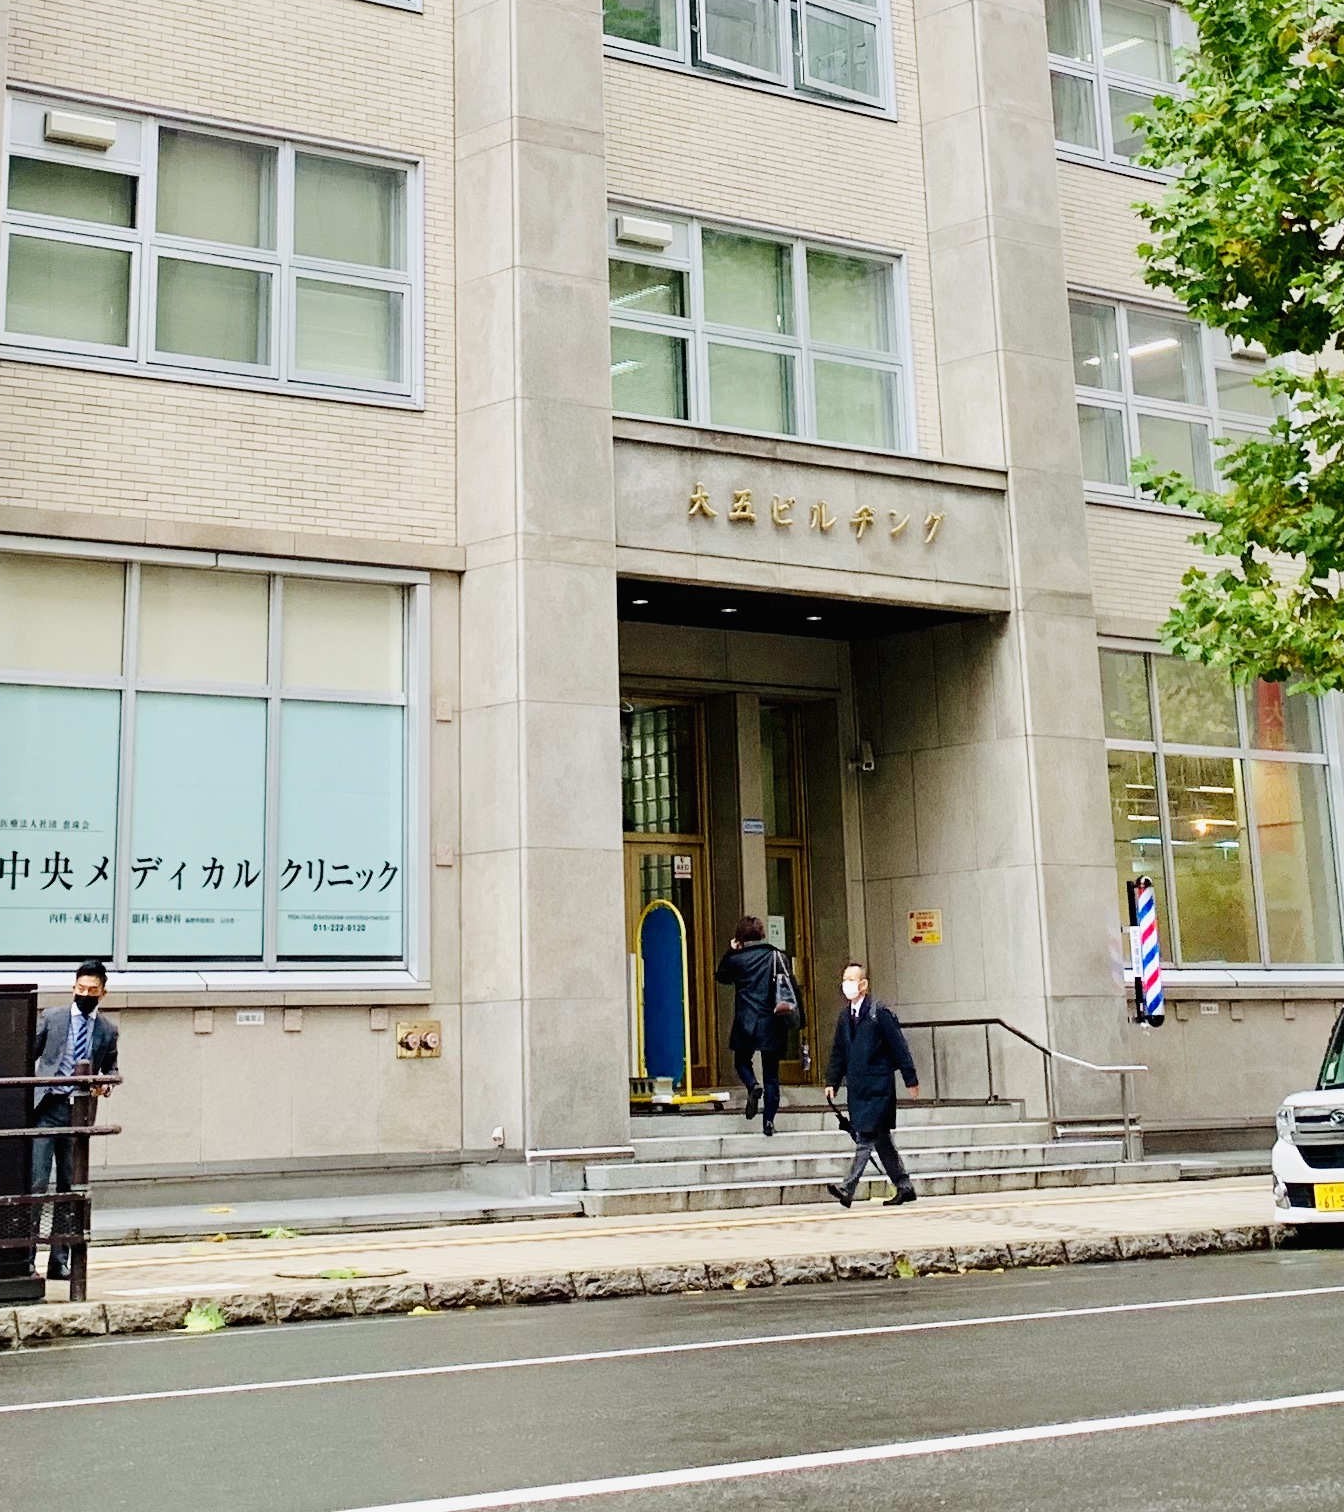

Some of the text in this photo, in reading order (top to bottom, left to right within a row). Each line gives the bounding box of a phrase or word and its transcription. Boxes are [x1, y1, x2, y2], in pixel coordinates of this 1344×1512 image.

[688, 481, 945, 544] 大五ビルヂング
